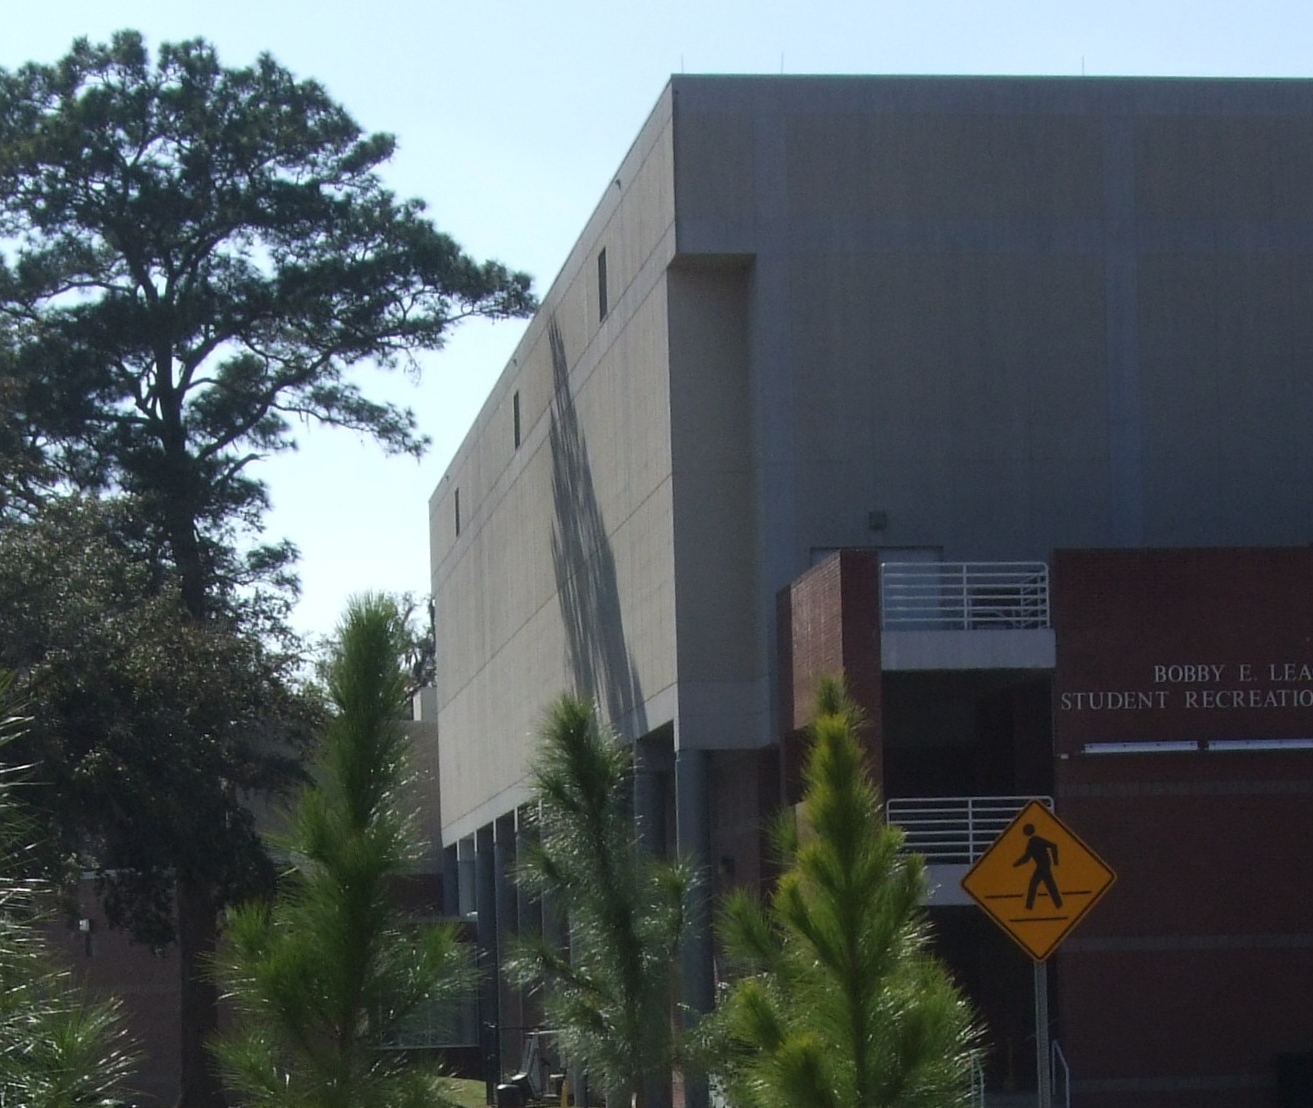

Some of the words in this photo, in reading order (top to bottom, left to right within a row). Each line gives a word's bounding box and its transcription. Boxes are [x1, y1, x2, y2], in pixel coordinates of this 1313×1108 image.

[1153, 664, 1225, 683] BOBBY
[1238, 664, 1258, 682] E.
[1061, 690, 1170, 710] STUDENT
